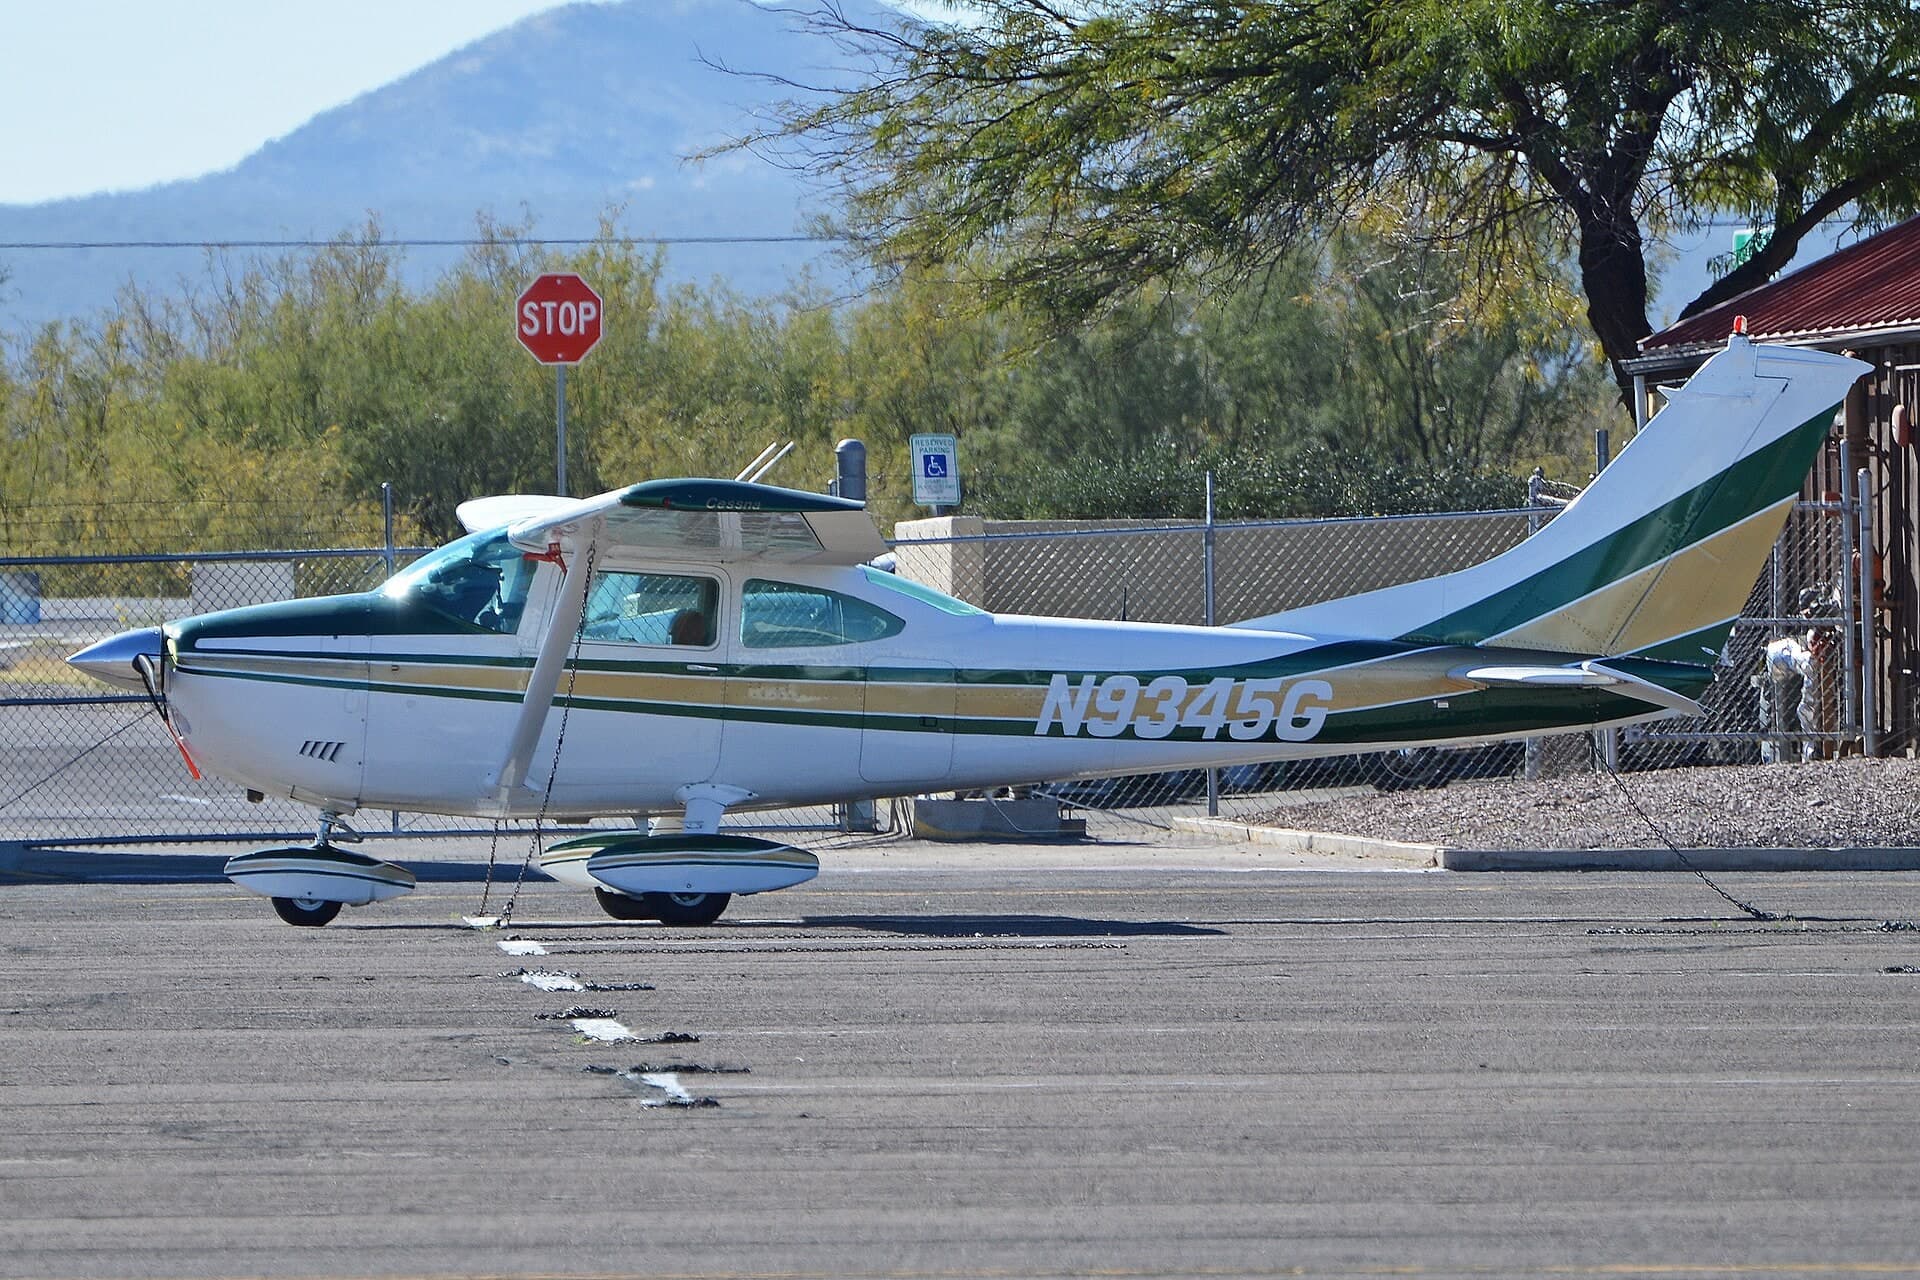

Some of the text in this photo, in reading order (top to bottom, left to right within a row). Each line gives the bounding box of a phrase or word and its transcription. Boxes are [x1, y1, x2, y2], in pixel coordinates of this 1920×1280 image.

[521, 301, 597, 336] STOP
[706, 497, 760, 510] Cessna
[1034, 673, 1333, 742] N9345G
